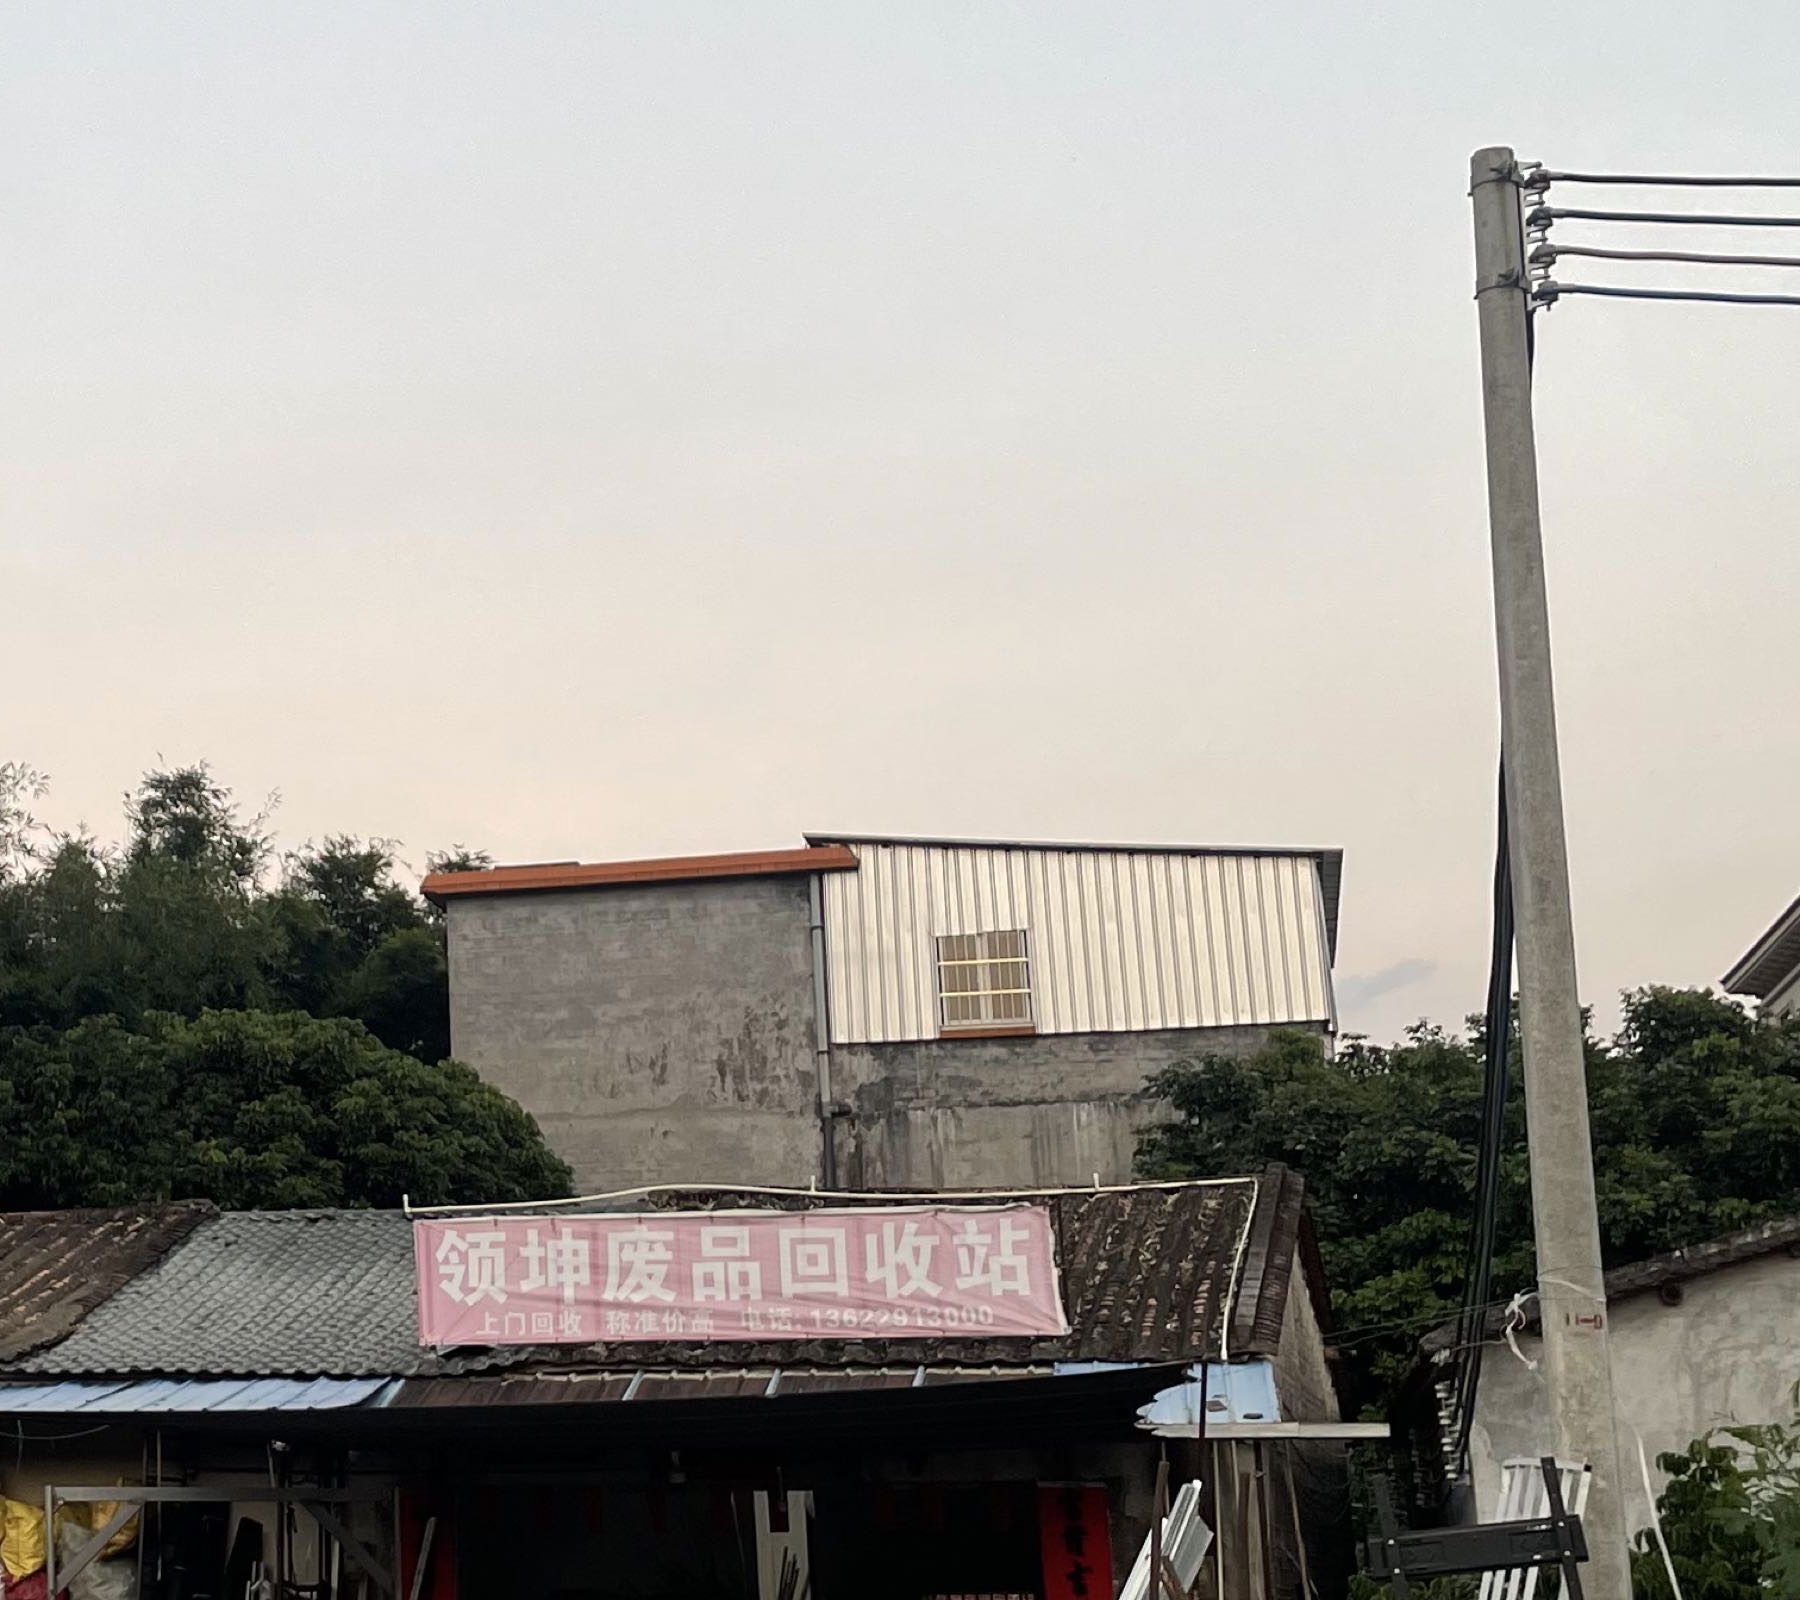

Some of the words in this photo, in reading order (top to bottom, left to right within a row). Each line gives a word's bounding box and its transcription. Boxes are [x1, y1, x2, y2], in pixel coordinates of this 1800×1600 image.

[435, 1220, 1032, 1305] 领坤废品回收站
[475, 1308, 582, 1336] 上门回收
[605, 1307, 714, 1335] 称准价高
